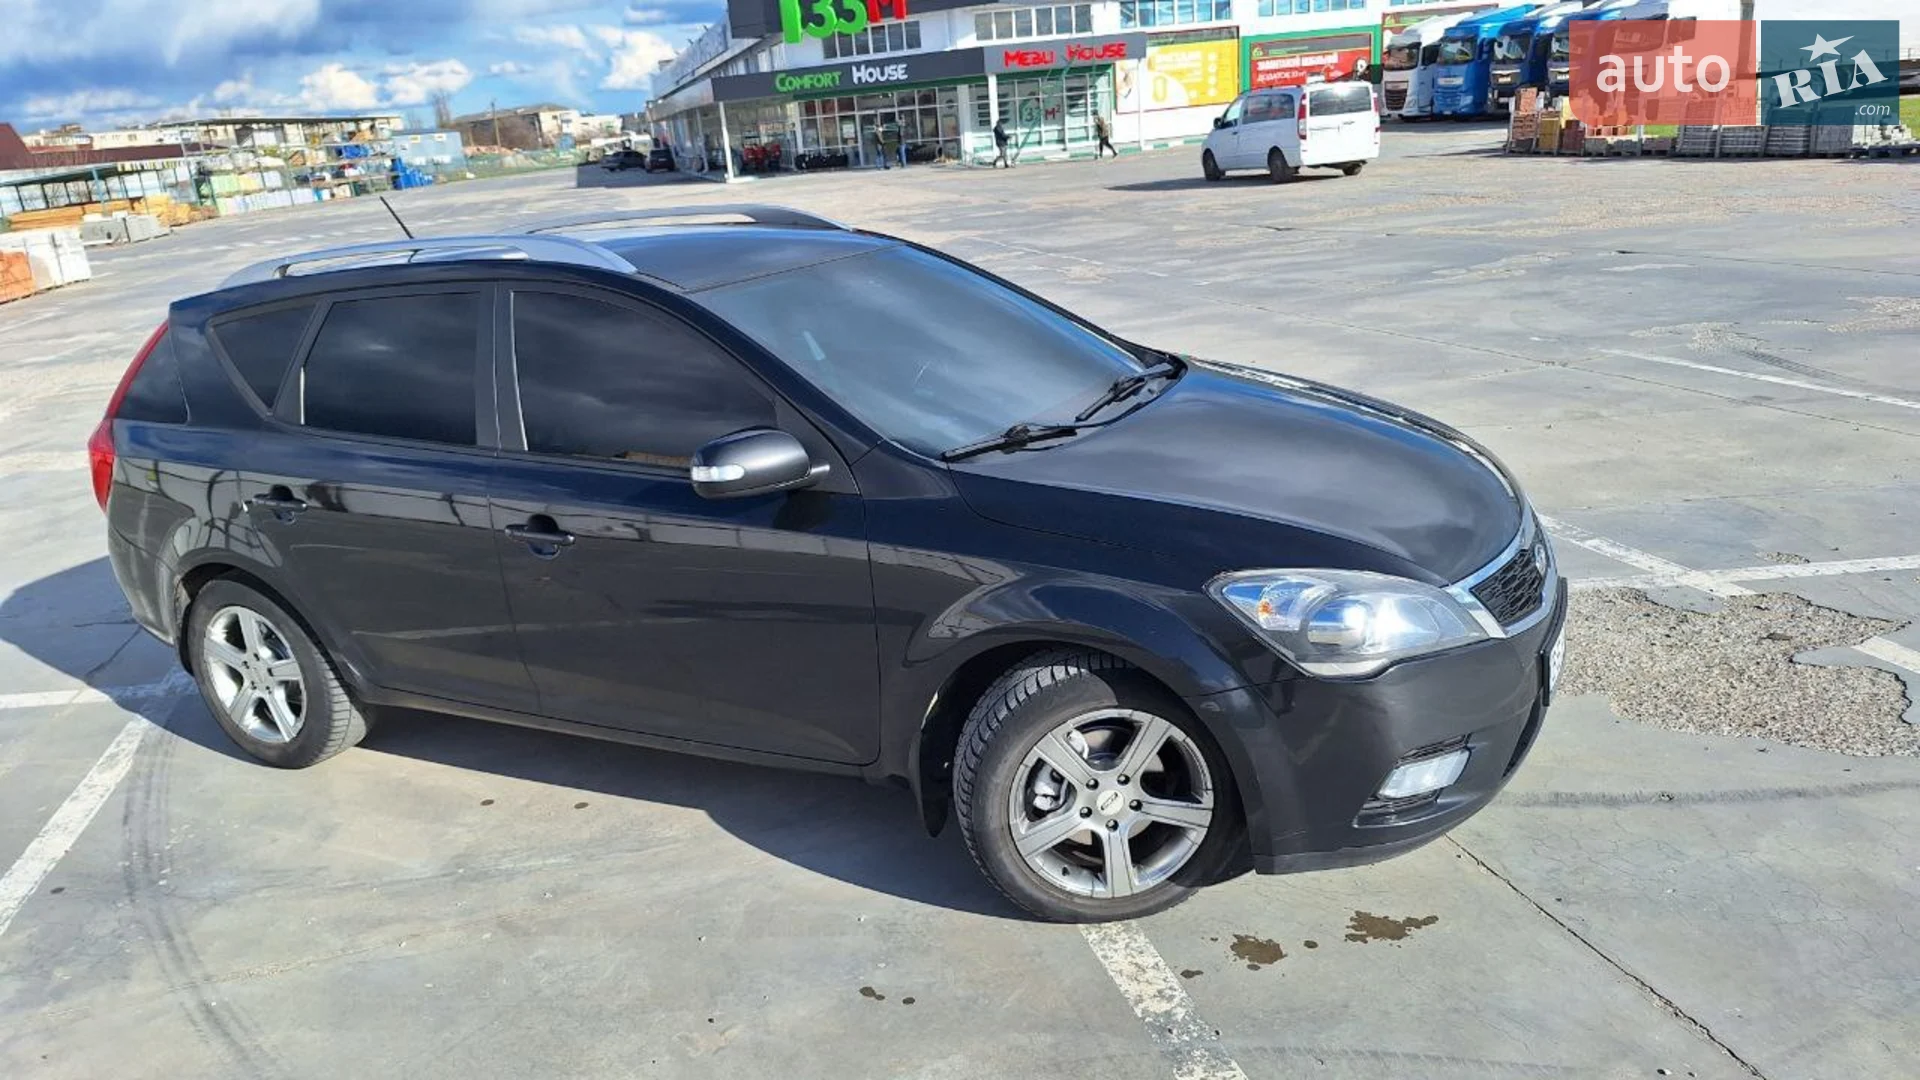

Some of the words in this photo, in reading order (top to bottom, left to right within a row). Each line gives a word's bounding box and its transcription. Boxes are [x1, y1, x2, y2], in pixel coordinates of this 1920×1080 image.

[1004, 49, 1055, 68] MEBLI
[1066, 42, 1127, 61] HOUSE
[775, 71, 842, 92] COMFORT
[852, 63, 909, 85] HOUSE
